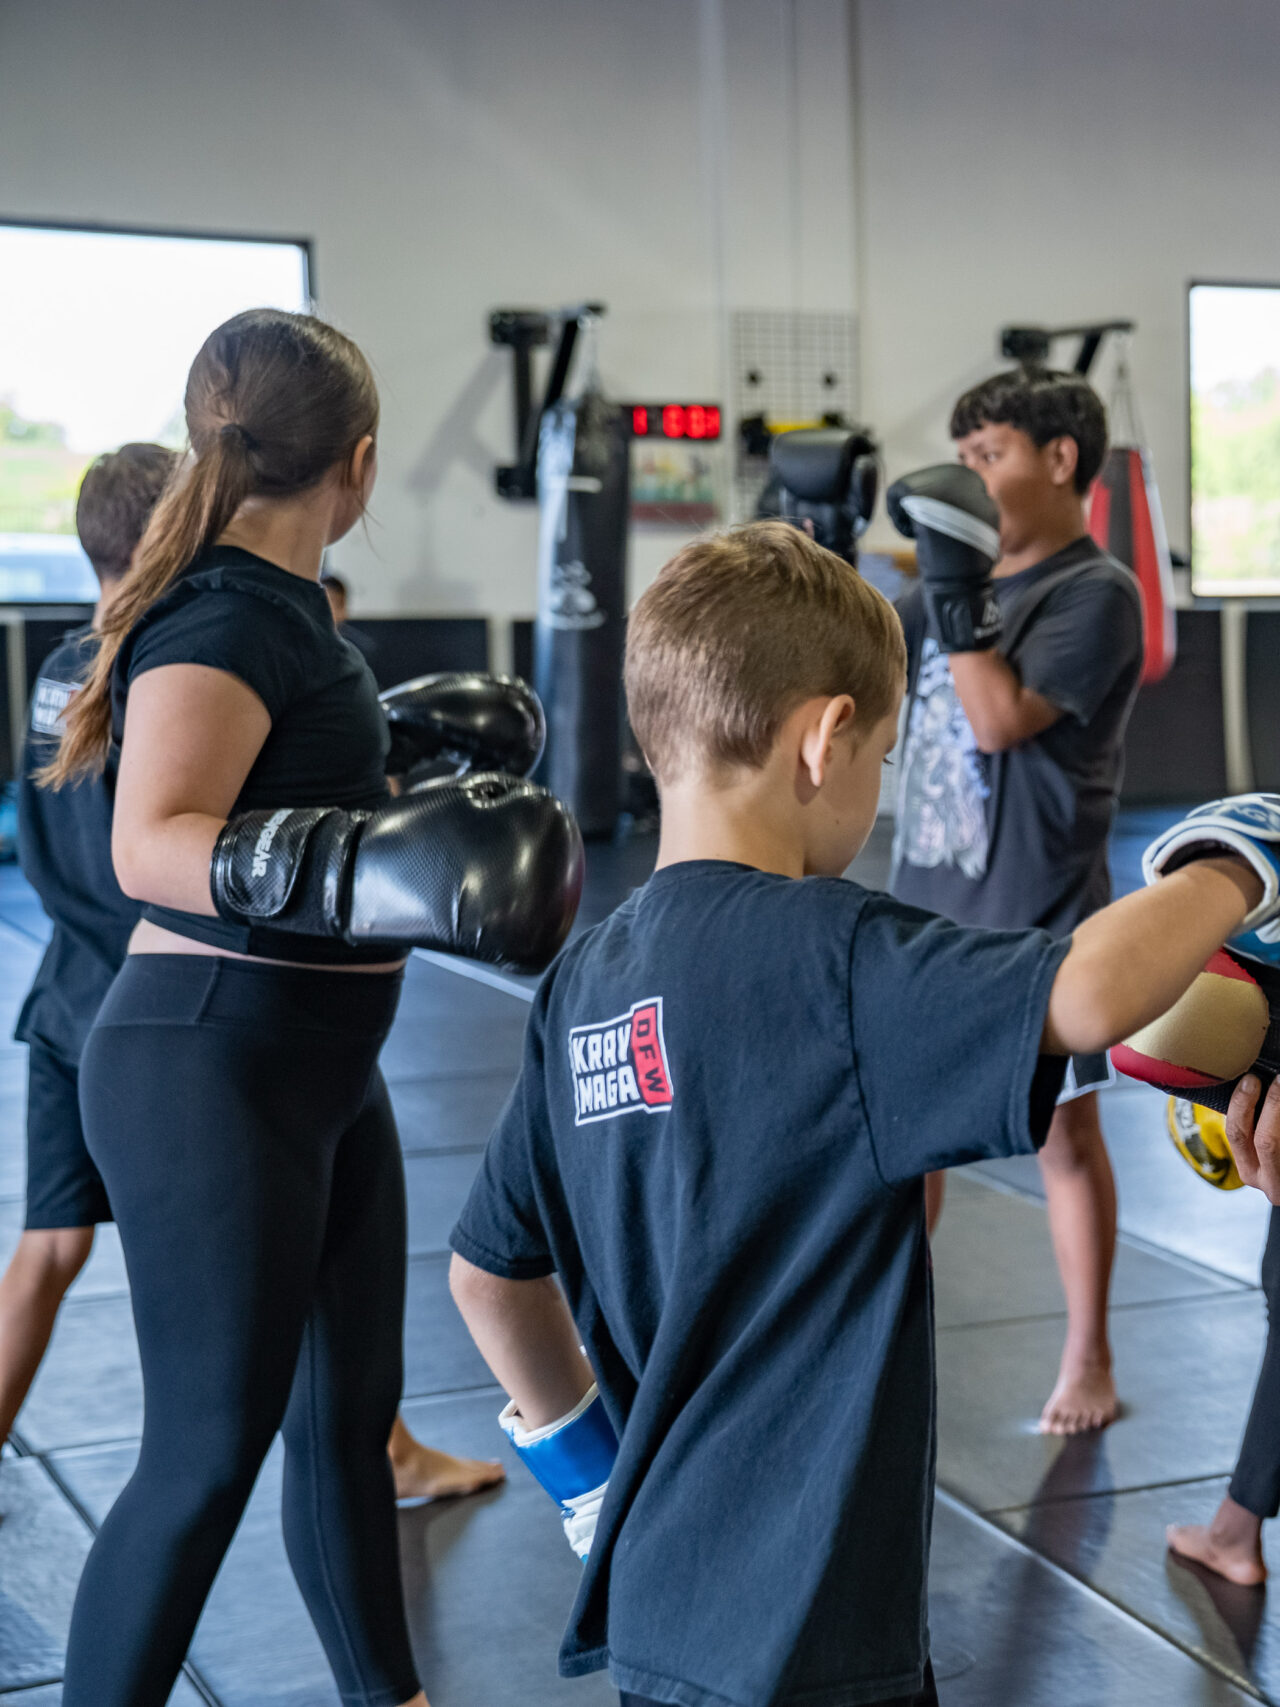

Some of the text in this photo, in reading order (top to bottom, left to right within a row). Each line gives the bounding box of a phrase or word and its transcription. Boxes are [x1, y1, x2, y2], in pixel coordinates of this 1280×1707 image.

[573, 1023, 631, 1074] KRAV
[637, 1018, 666, 1093] DFW
[578, 1065, 640, 1114] MAGA
